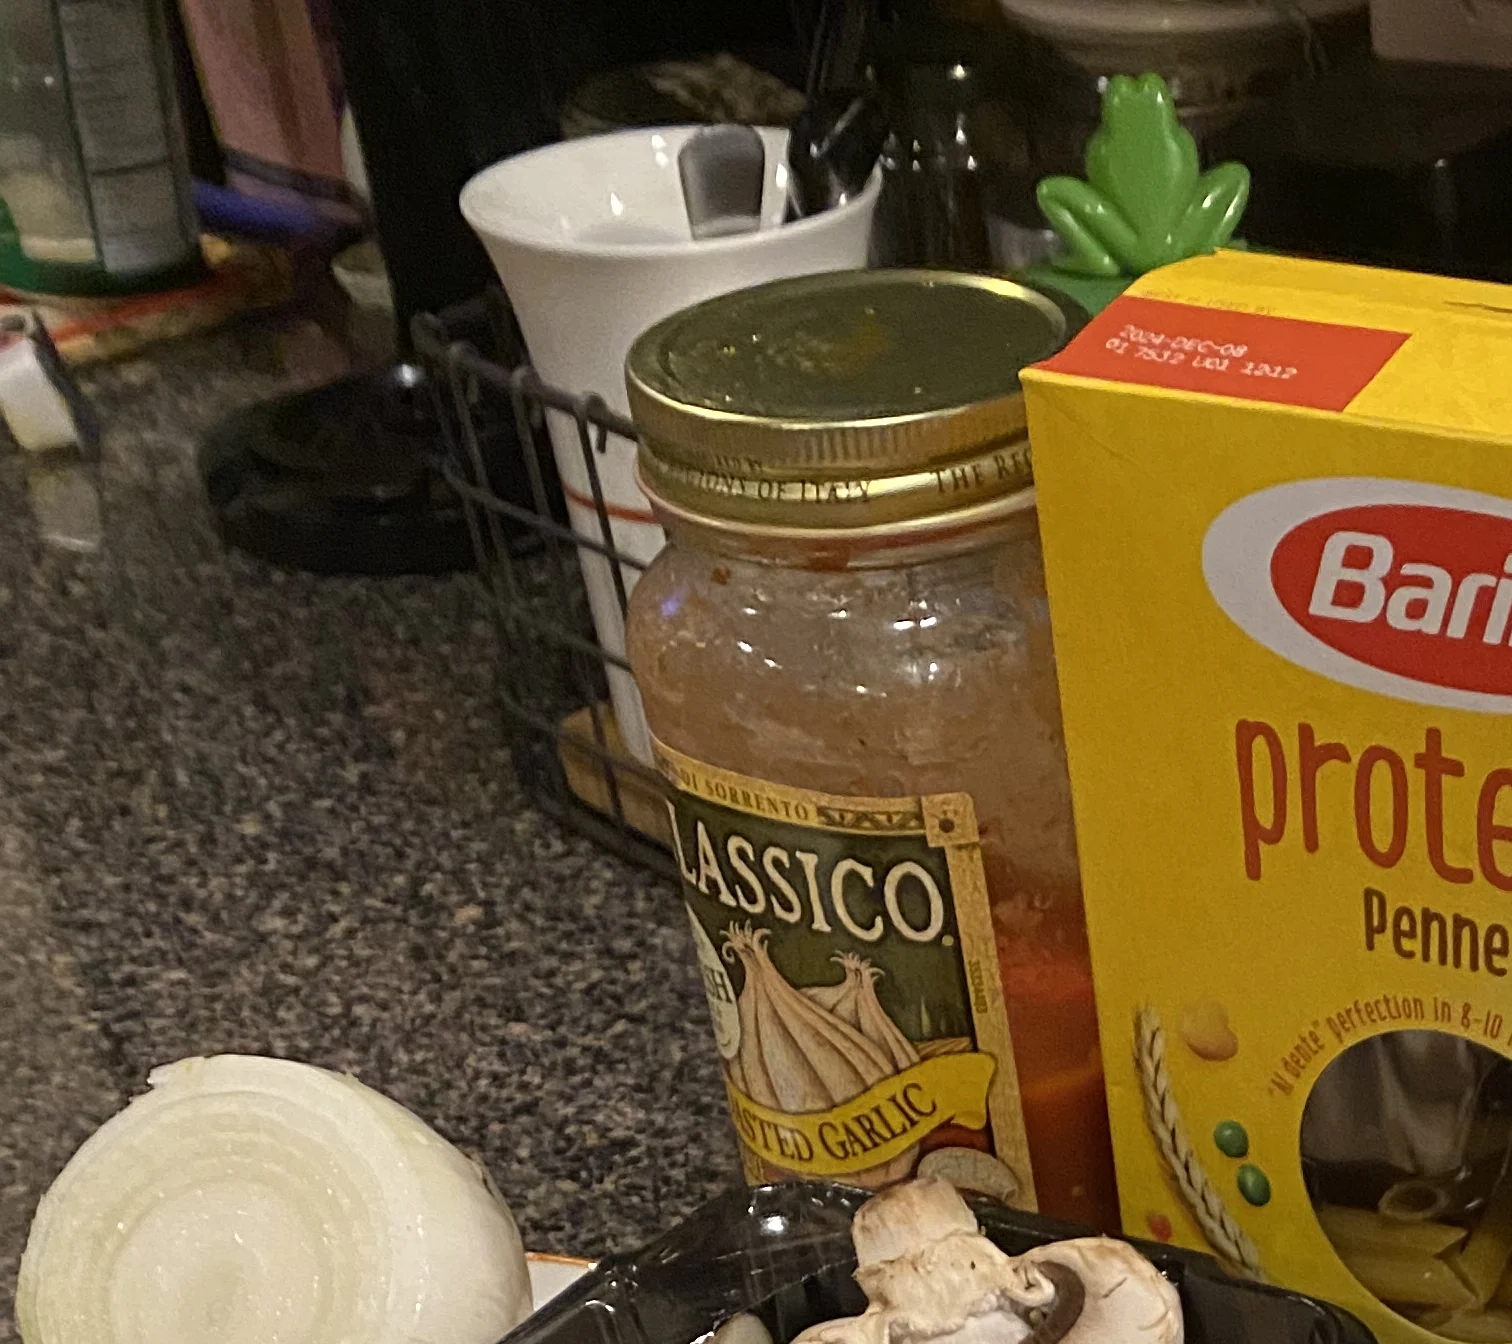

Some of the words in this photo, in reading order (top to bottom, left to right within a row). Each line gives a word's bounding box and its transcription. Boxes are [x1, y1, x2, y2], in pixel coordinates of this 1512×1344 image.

[758, 480, 787, 501] OF
[800, 479, 871, 504] ITALY
[931, 461, 986, 494] THE
[704, 780, 809, 821] SORRENTO
[667, 800, 944, 943] LASSICO
[1363, 887, 1510, 977] Penne
[1326, 994, 1425, 1044] perfection
[1433, 996, 1451, 1023] in
[1460, 1002, 1503, 1039] 8-10
[818, 1083, 937, 1161] GARLIC
